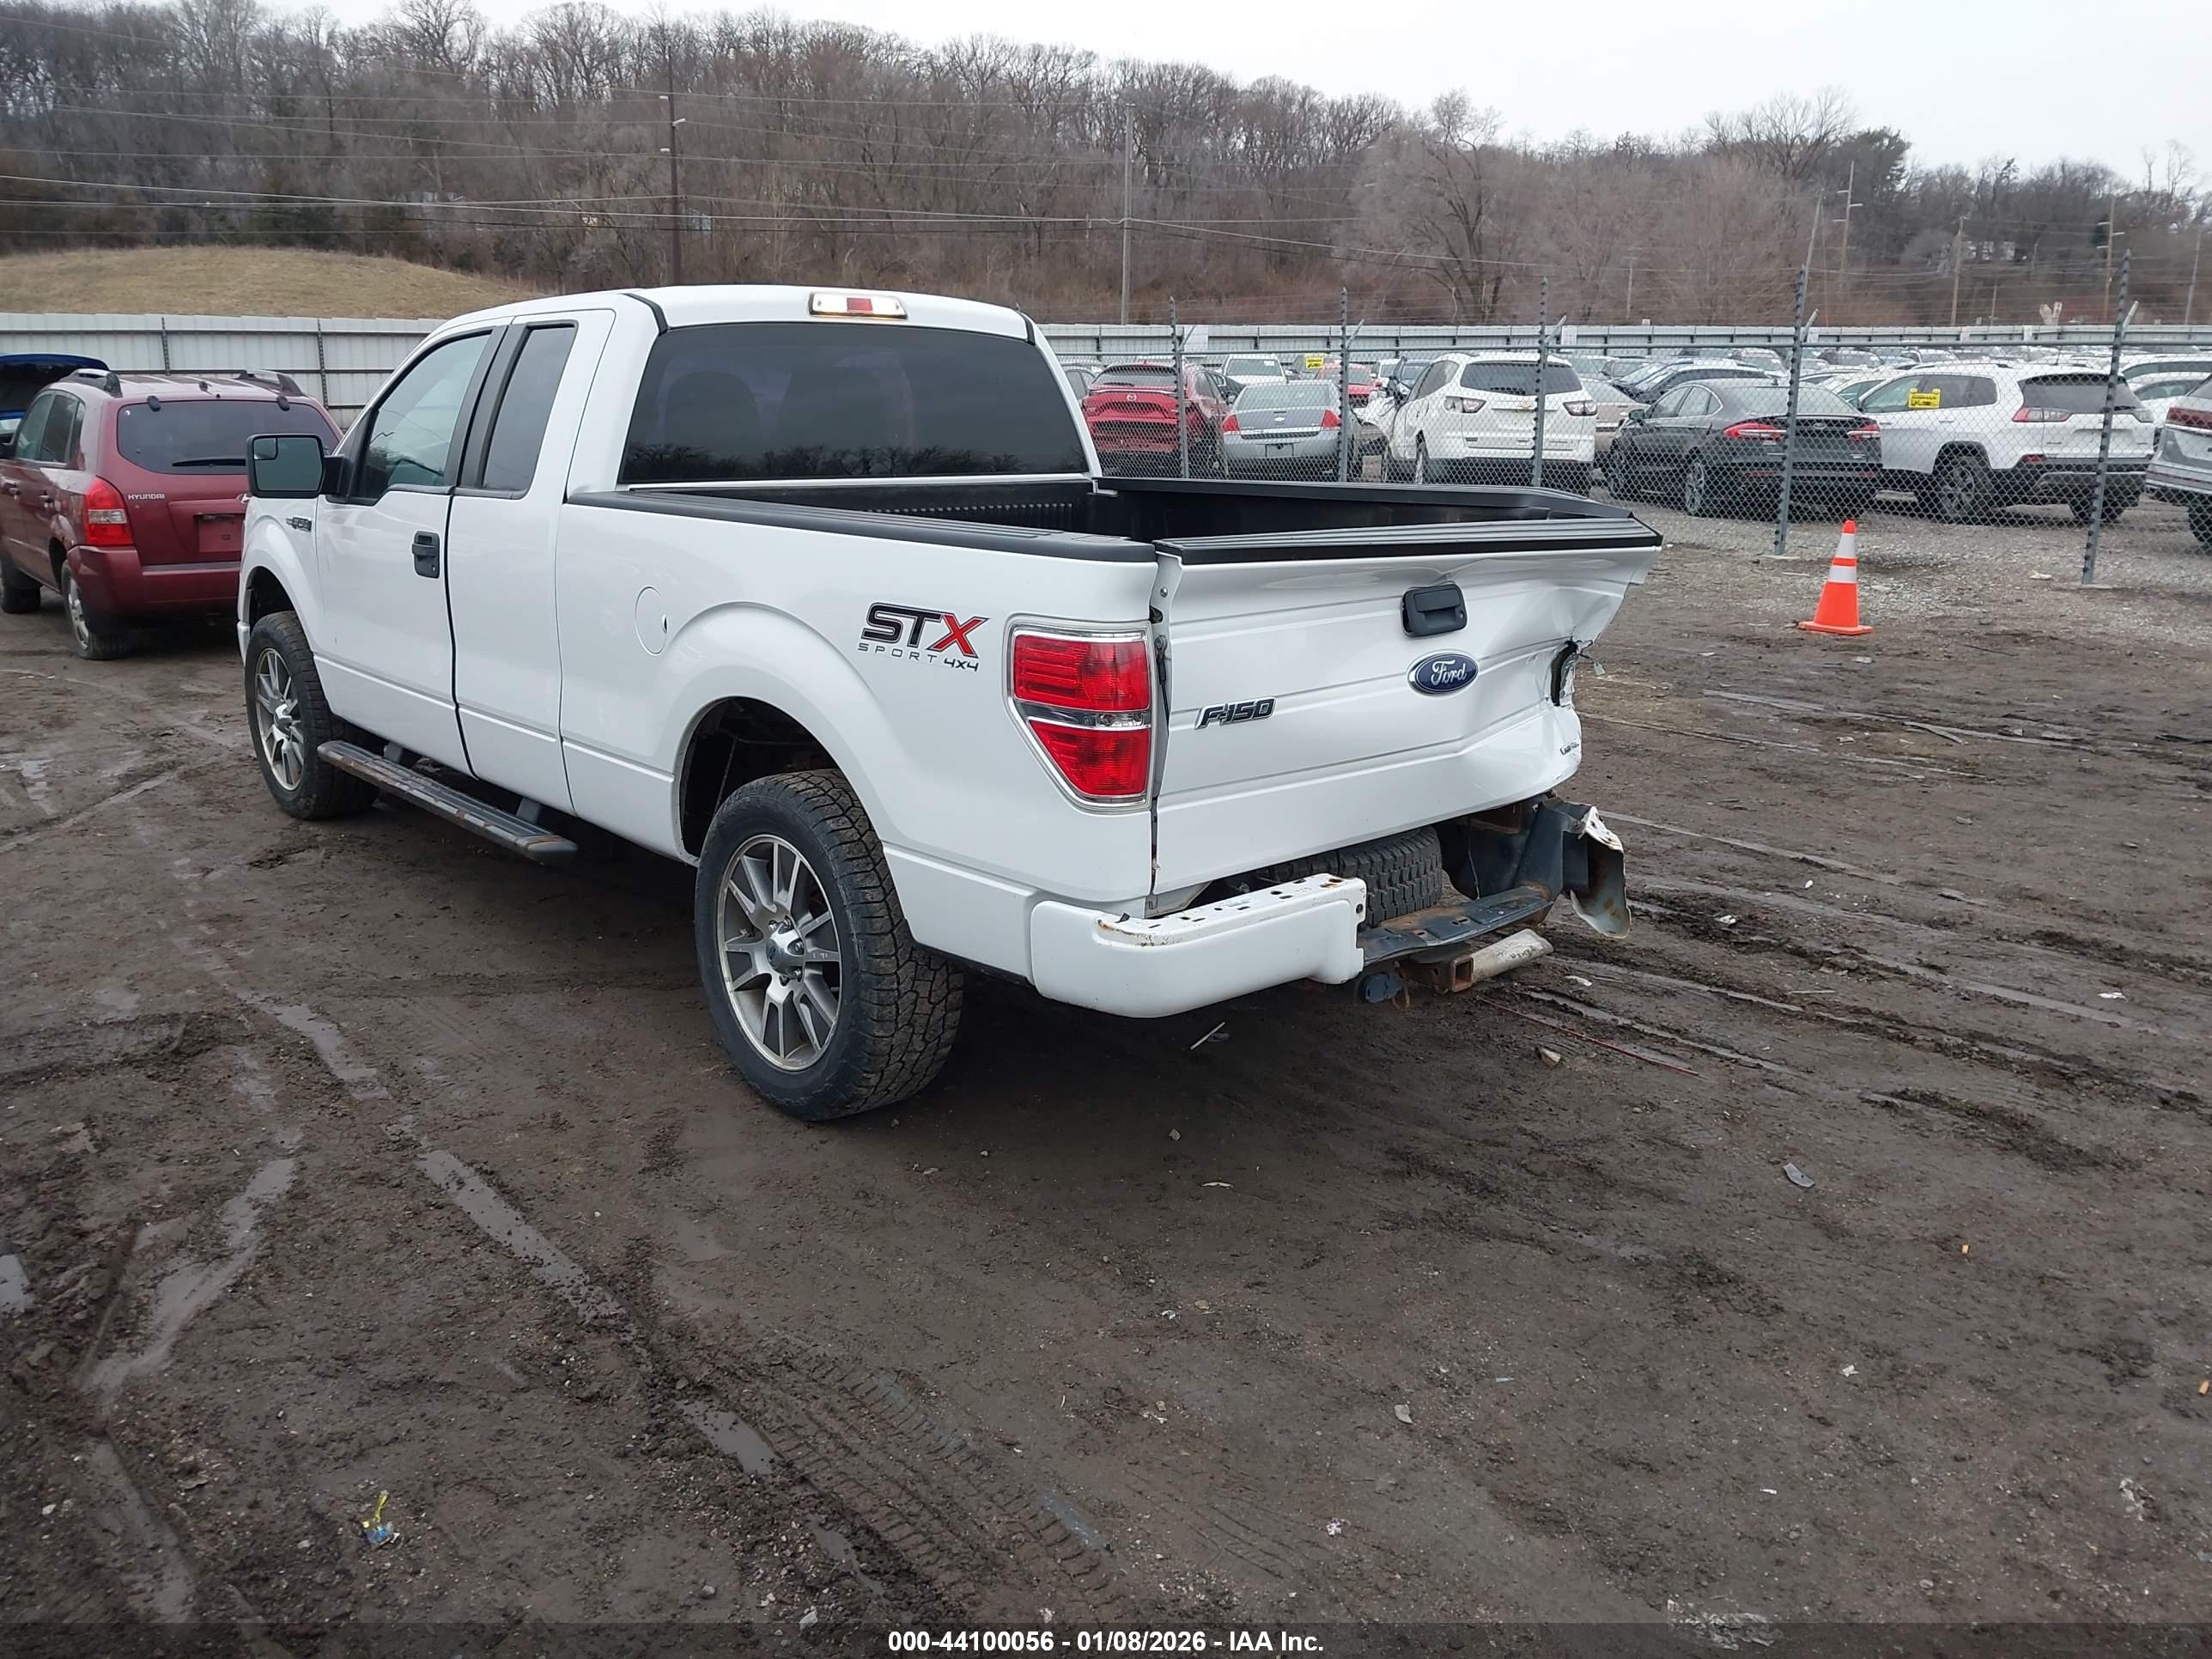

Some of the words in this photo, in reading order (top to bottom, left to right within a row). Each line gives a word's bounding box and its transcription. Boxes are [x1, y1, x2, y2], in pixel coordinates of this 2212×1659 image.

[861, 602, 989, 659] STX
[858, 643, 937, 663] SPORT
[1431, 659, 1467, 685] Ford
